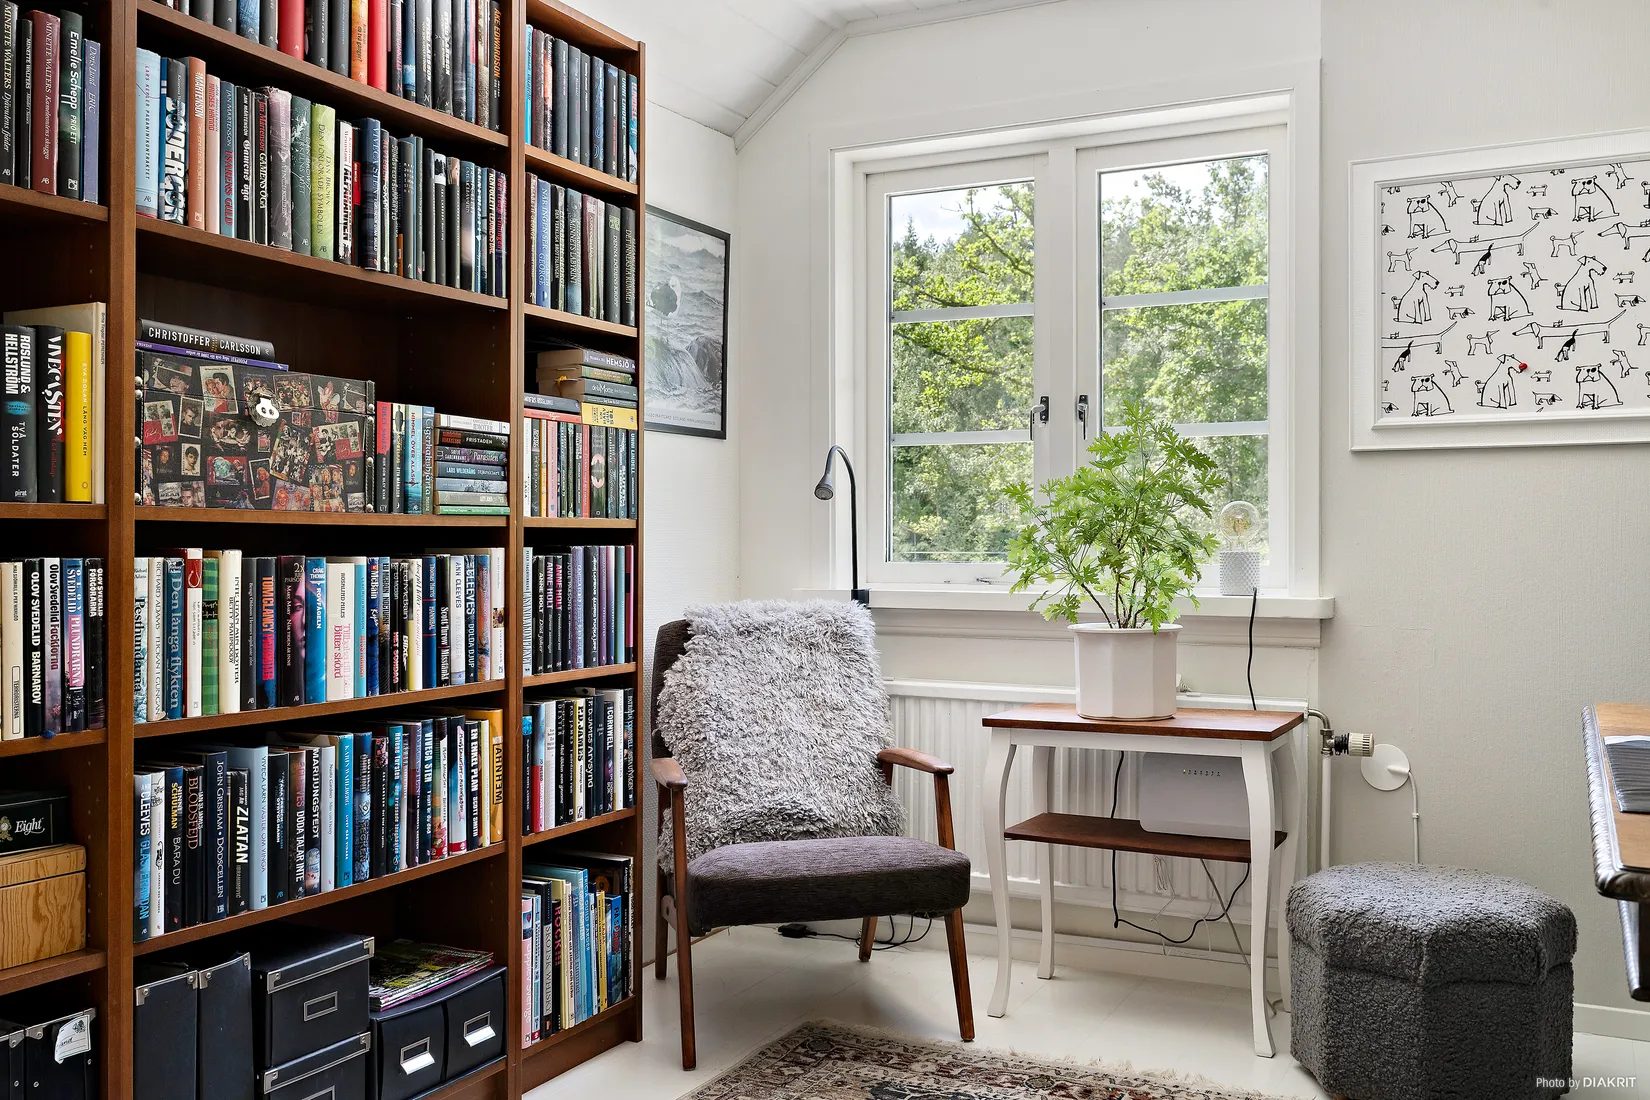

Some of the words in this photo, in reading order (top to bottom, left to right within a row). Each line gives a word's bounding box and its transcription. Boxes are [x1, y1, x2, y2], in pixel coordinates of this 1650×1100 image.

[4, 5, 12, 46] MINETTE
[70, 31, 82, 69] Emelie
[4, 49, 12, 89] WALTERS
[61, 71, 81, 109] Schepp
[258, 100, 266, 113] Jan
[3, 92, 12, 128] Djävulens
[224, 150, 233, 196] TSARENS
[259, 152, 267, 190] GAMENS
[224, 198, 233, 226] GULD
[260, 190, 268, 209] ÖGA
[20, 335, 30, 383] ROSLUND
[148, 327, 210, 347] CHRISTOFFER
[219, 339, 261, 355] CARLSSON
[5, 333, 20, 394] HELLSTRÖM
[47, 335, 62, 390] VIVECA
[606, 358, 630, 369] HEMSJÖ
[21, 384, 30, 394] &
[18, 422, 27, 438] TVÅ
[42, 390, 63, 435] STEN
[32, 572, 40, 597] OLOV
[49, 564, 59, 584] Olov
[66, 569, 77, 613] SVEDELID
[262, 576, 274, 596] TOM
[466, 569, 475, 615] CLEEVES
[50, 585, 59, 622] Svedelid
[89, 568, 97, 617] FÖRGÖRARNA
[171, 578, 182, 610] Den
[32, 599, 41, 646] SVEDELID
[168, 613, 182, 654] långa
[262, 598, 274, 633] CLANCY
[440, 607, 449, 624] Scott
[50, 623, 59, 670] Facklorna
[70, 617, 82, 684] PLUNDRARNA
[134, 597, 146, 692] Pesthundarna
[334, 624, 342, 651] Bitter
[440, 626, 449, 645] Turow
[32, 651, 41, 705] BARNAROV
[168, 656, 182, 709] flykten
[334, 652, 343, 679] skörd
[441, 649, 449, 680] Misstänkt
[471, 729, 478, 740] EN
[606, 710, 614, 750] CORNWELL
[471, 769, 479, 791] PLAN
[15, 817, 45, 835] Eight
[186, 777, 198, 849] BLODSFEJD
[296, 811, 305, 834] DÖDA
[236, 806, 248, 863] ZLATAN
[261, 833, 266, 846] OM
[296, 835, 305, 862] TALAR
[172, 869, 180, 885] DU
[296, 864, 304, 882] INTE
[544, 926, 553, 969] SKOTSK
[544, 971, 552, 1013] WHISKY
